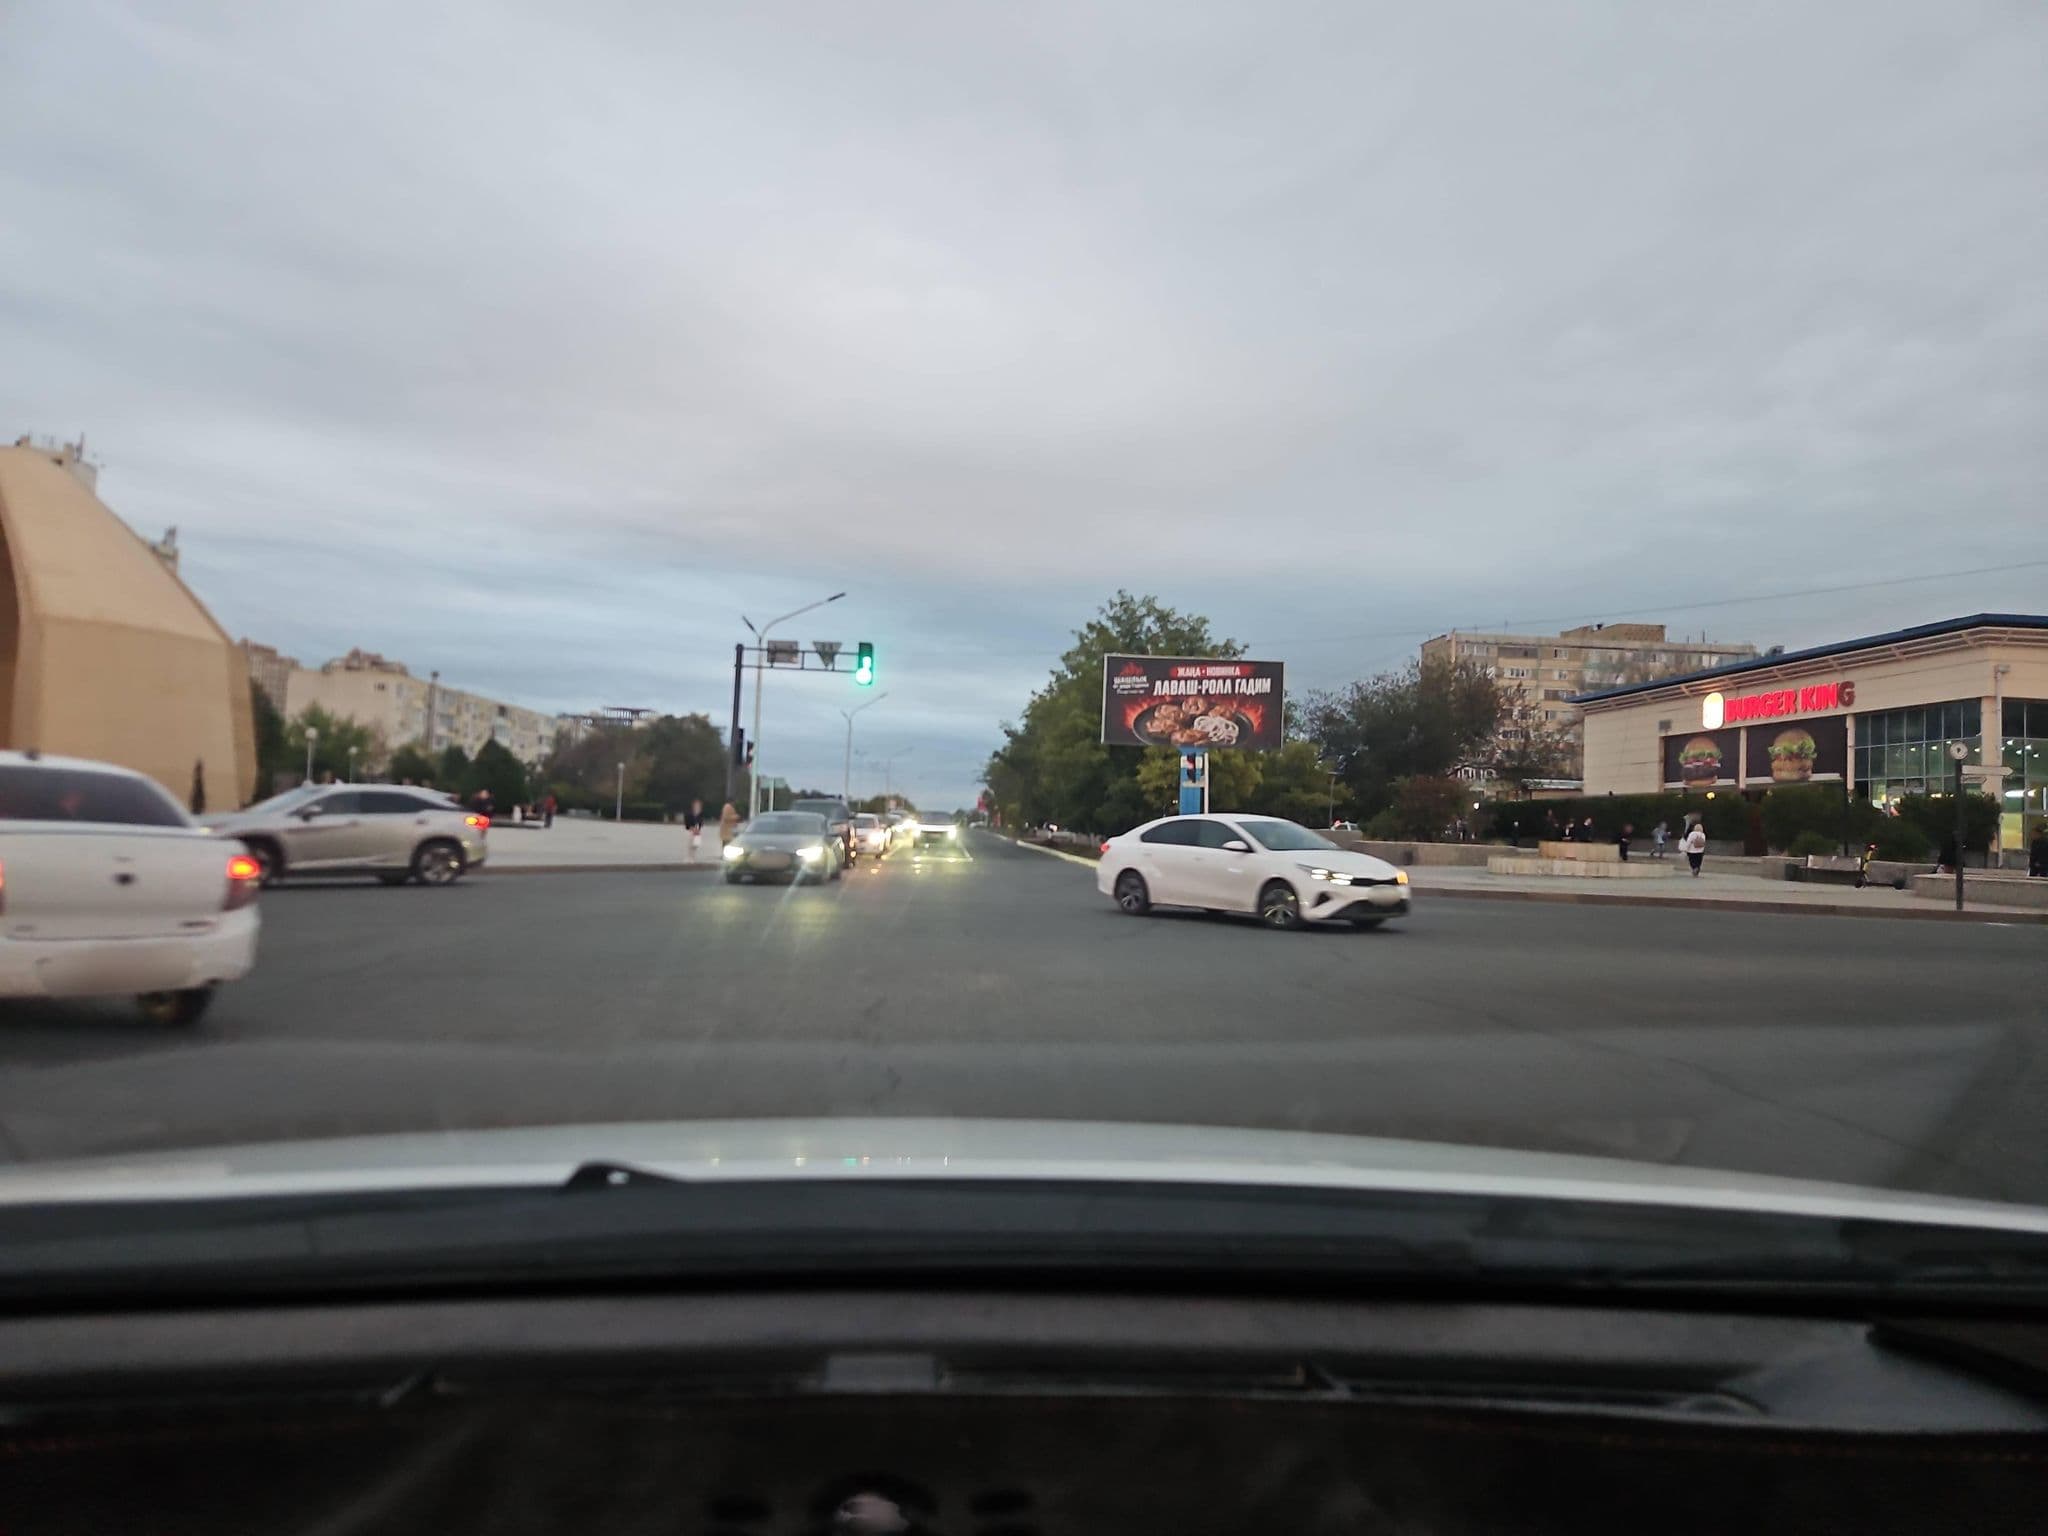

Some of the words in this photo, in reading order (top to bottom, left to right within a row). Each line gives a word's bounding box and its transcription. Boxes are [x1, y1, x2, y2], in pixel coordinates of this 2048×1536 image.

[1234, 678, 1272, 696] ГАДИМ
[1725, 690, 1797, 722] BURGER
[1800, 681, 1855, 711] KING
